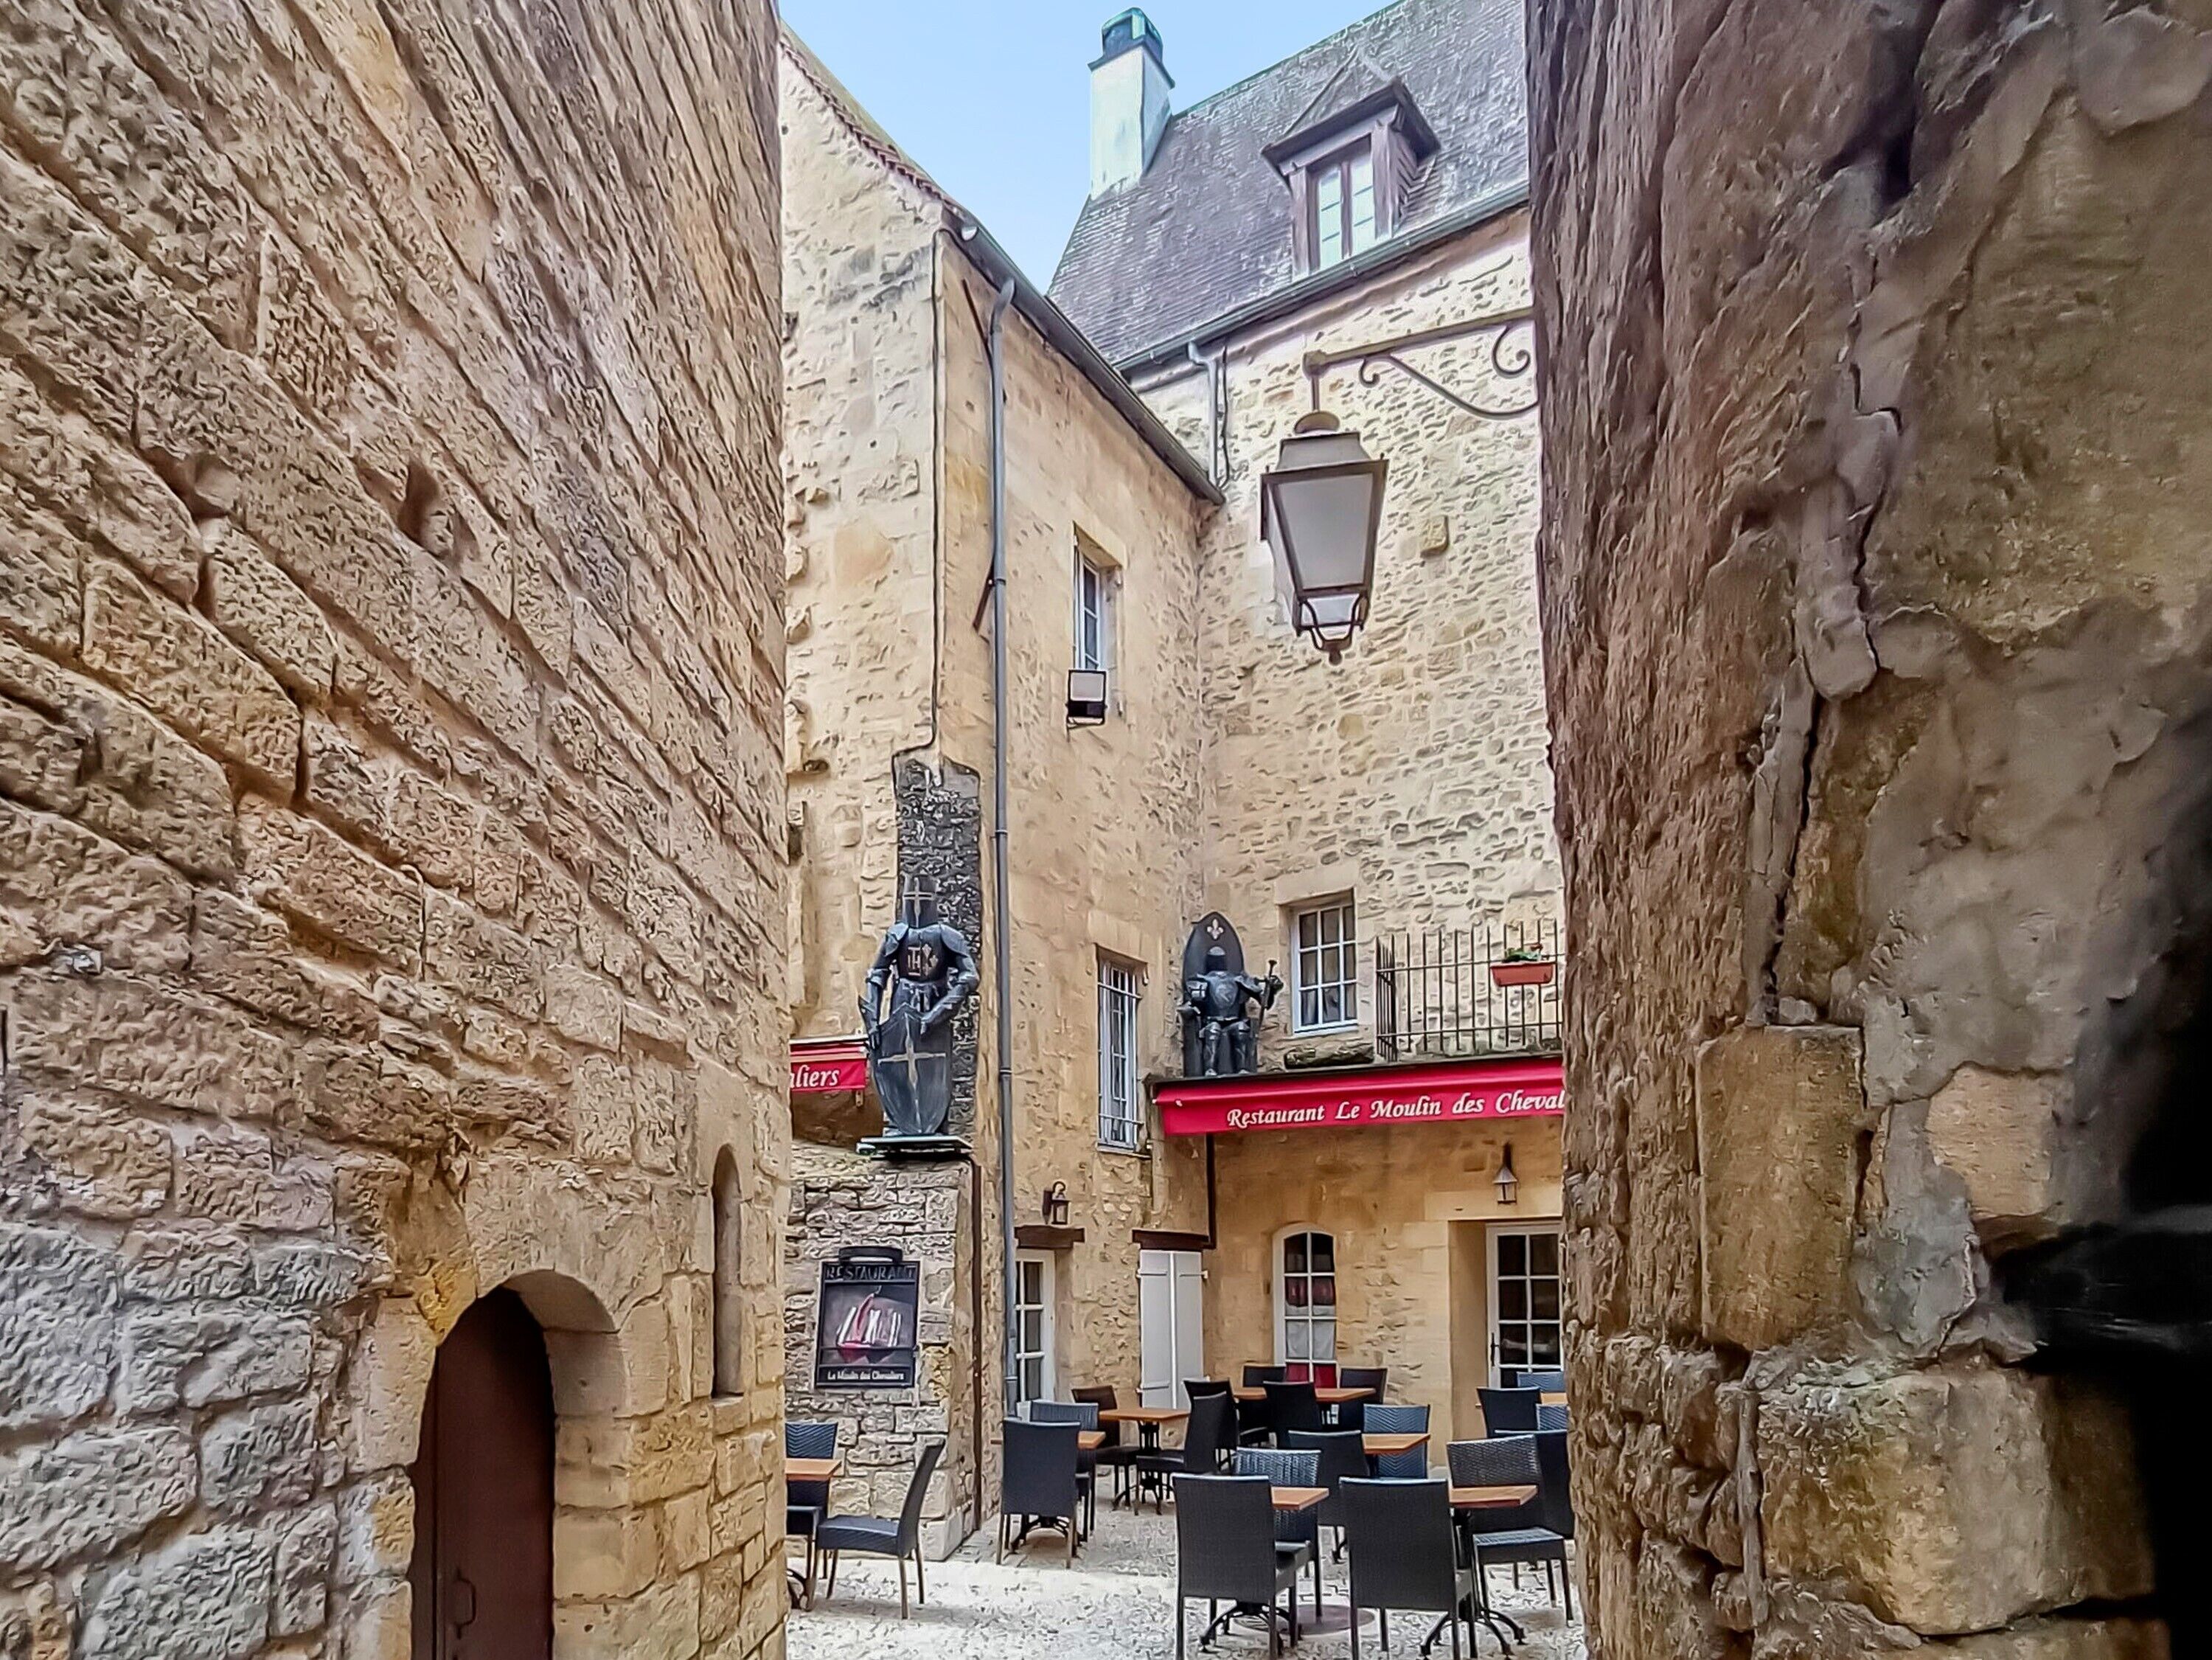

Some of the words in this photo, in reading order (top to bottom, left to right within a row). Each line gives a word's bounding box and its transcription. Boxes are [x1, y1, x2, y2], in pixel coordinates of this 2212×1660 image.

[1227, 1105, 1325, 1129] Restaurant
[1335, 1101, 1360, 1119] Le
[1369, 1095, 1441, 1119] Moulin
[1452, 1092, 1486, 1114] des
[1495, 1088, 1565, 1114] Cheval
[826, 1265, 916, 1280] RESTAURANT
